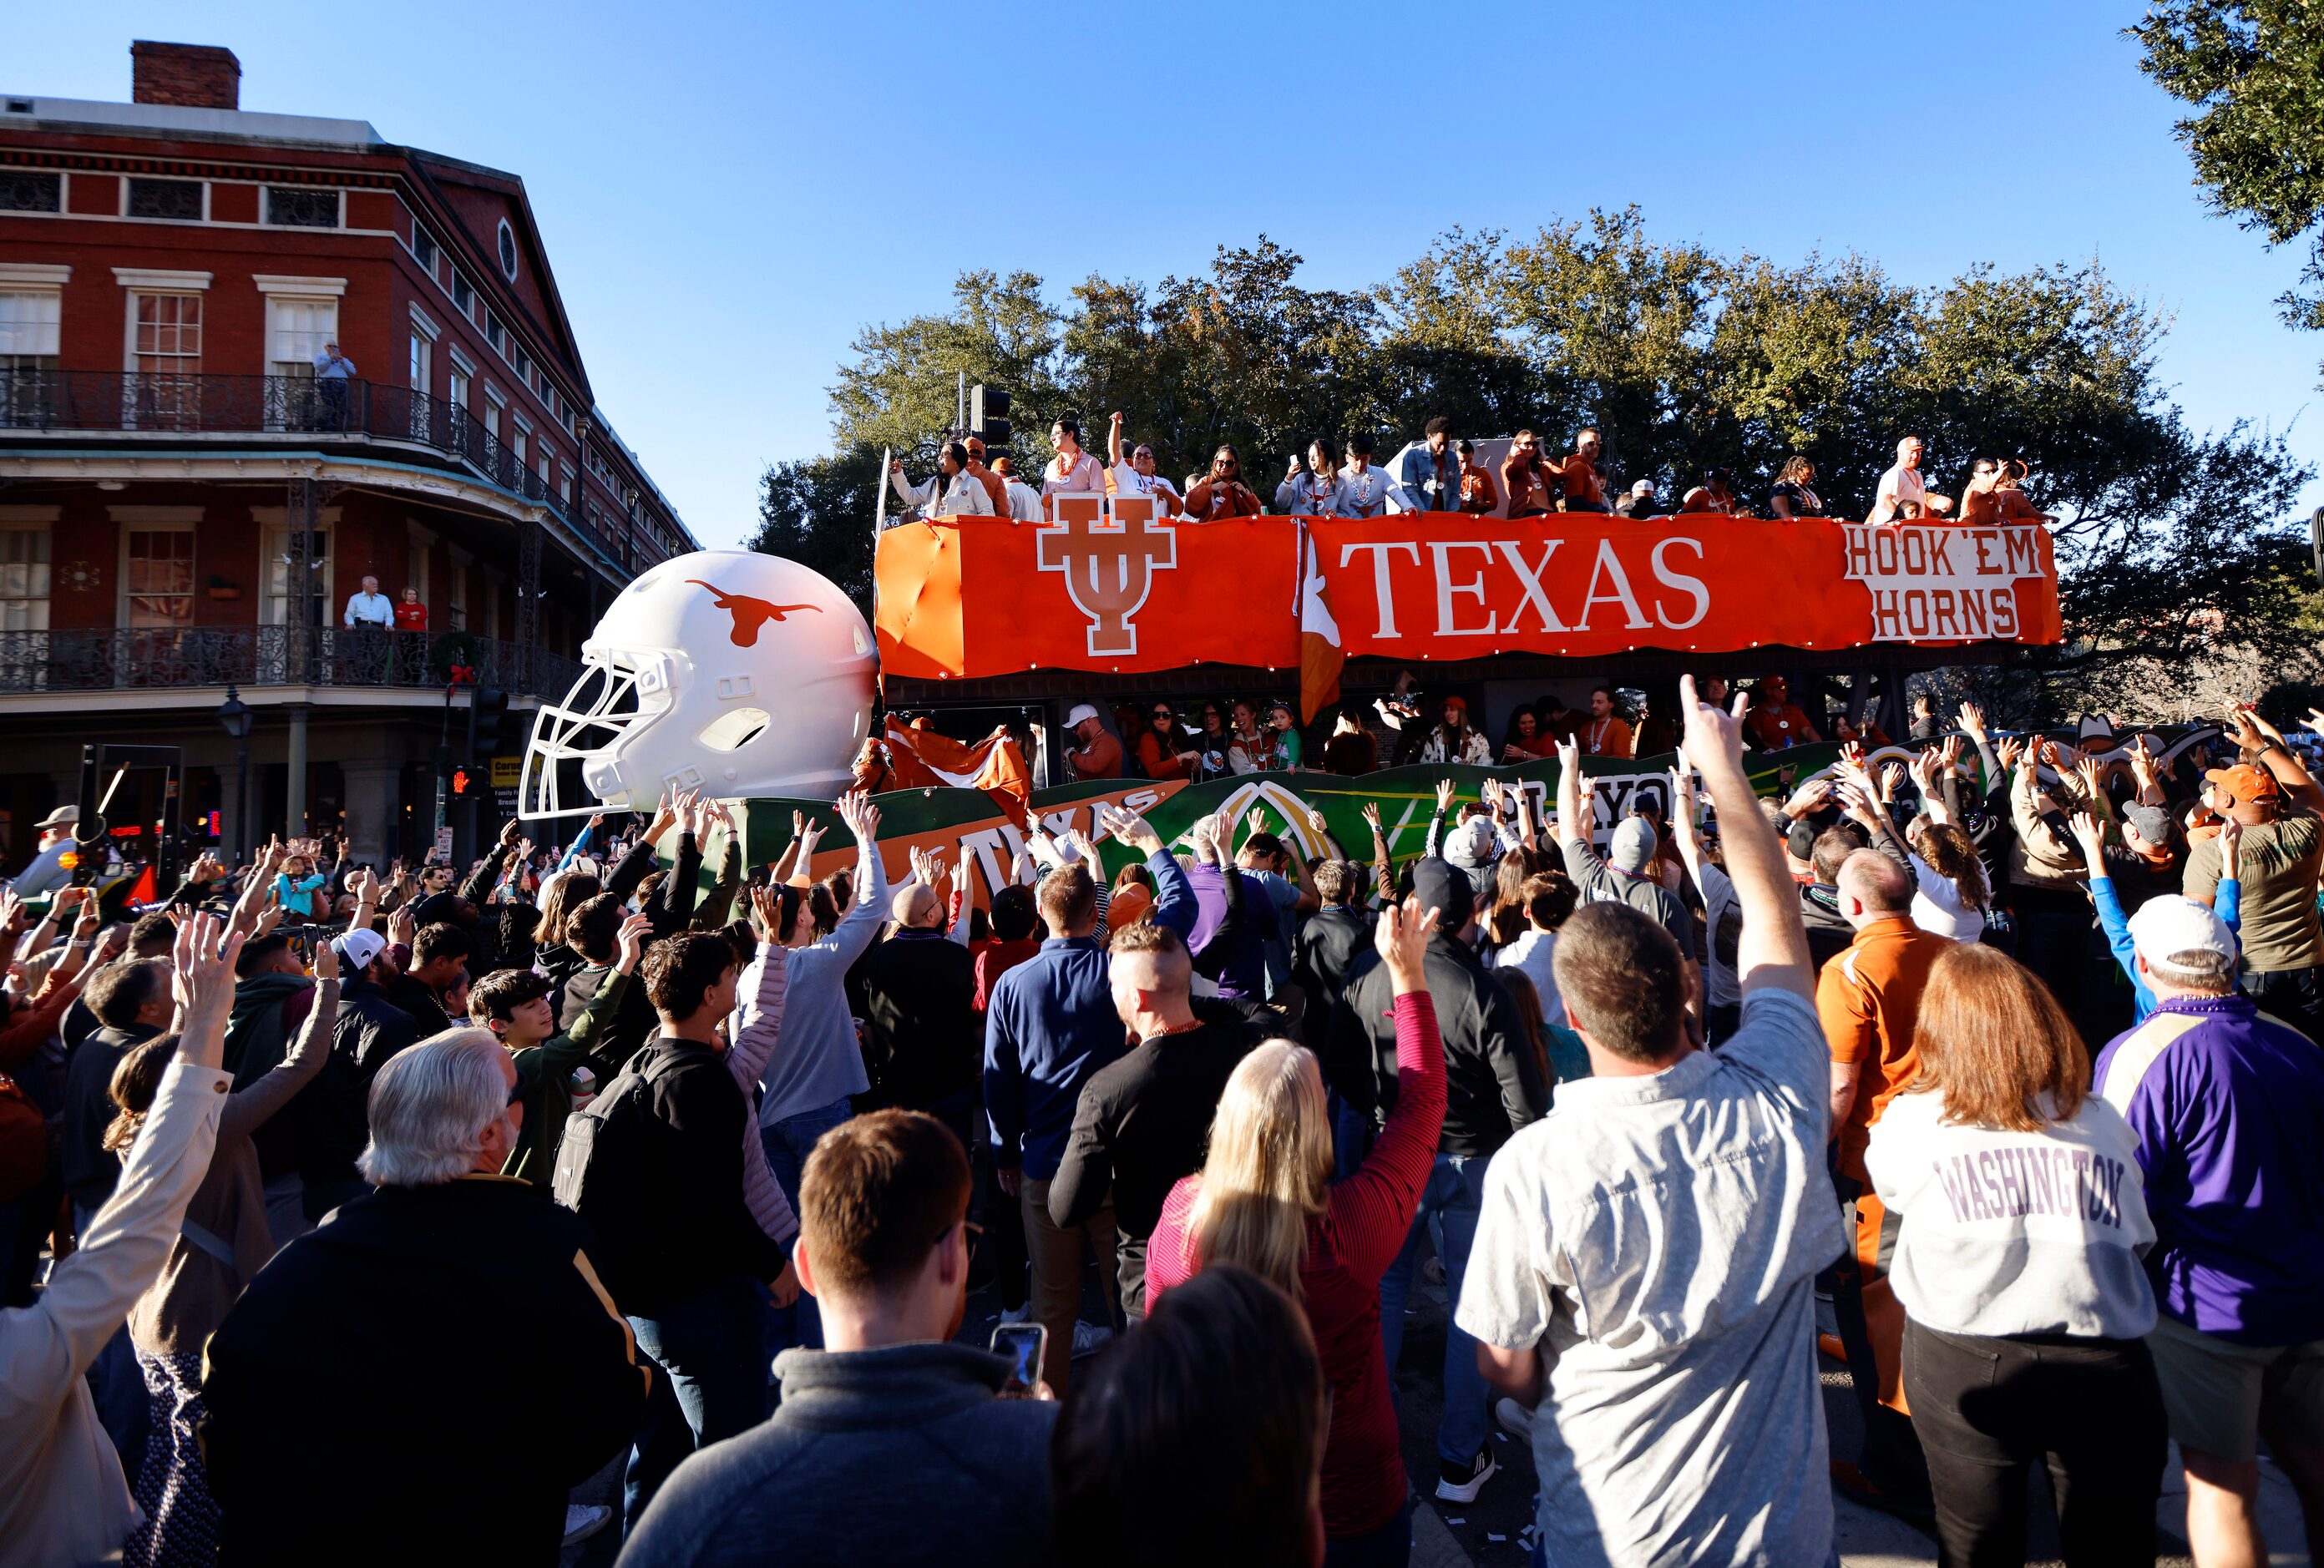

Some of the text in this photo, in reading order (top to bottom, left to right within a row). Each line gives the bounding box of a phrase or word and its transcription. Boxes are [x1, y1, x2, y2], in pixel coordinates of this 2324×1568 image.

[1847, 528, 2039, 576] HOOK 'EM
[1339, 536, 1710, 639] TEXAS
[1874, 587, 2017, 637] HORNS
[1932, 1147, 2125, 1229] WASHINGTON
